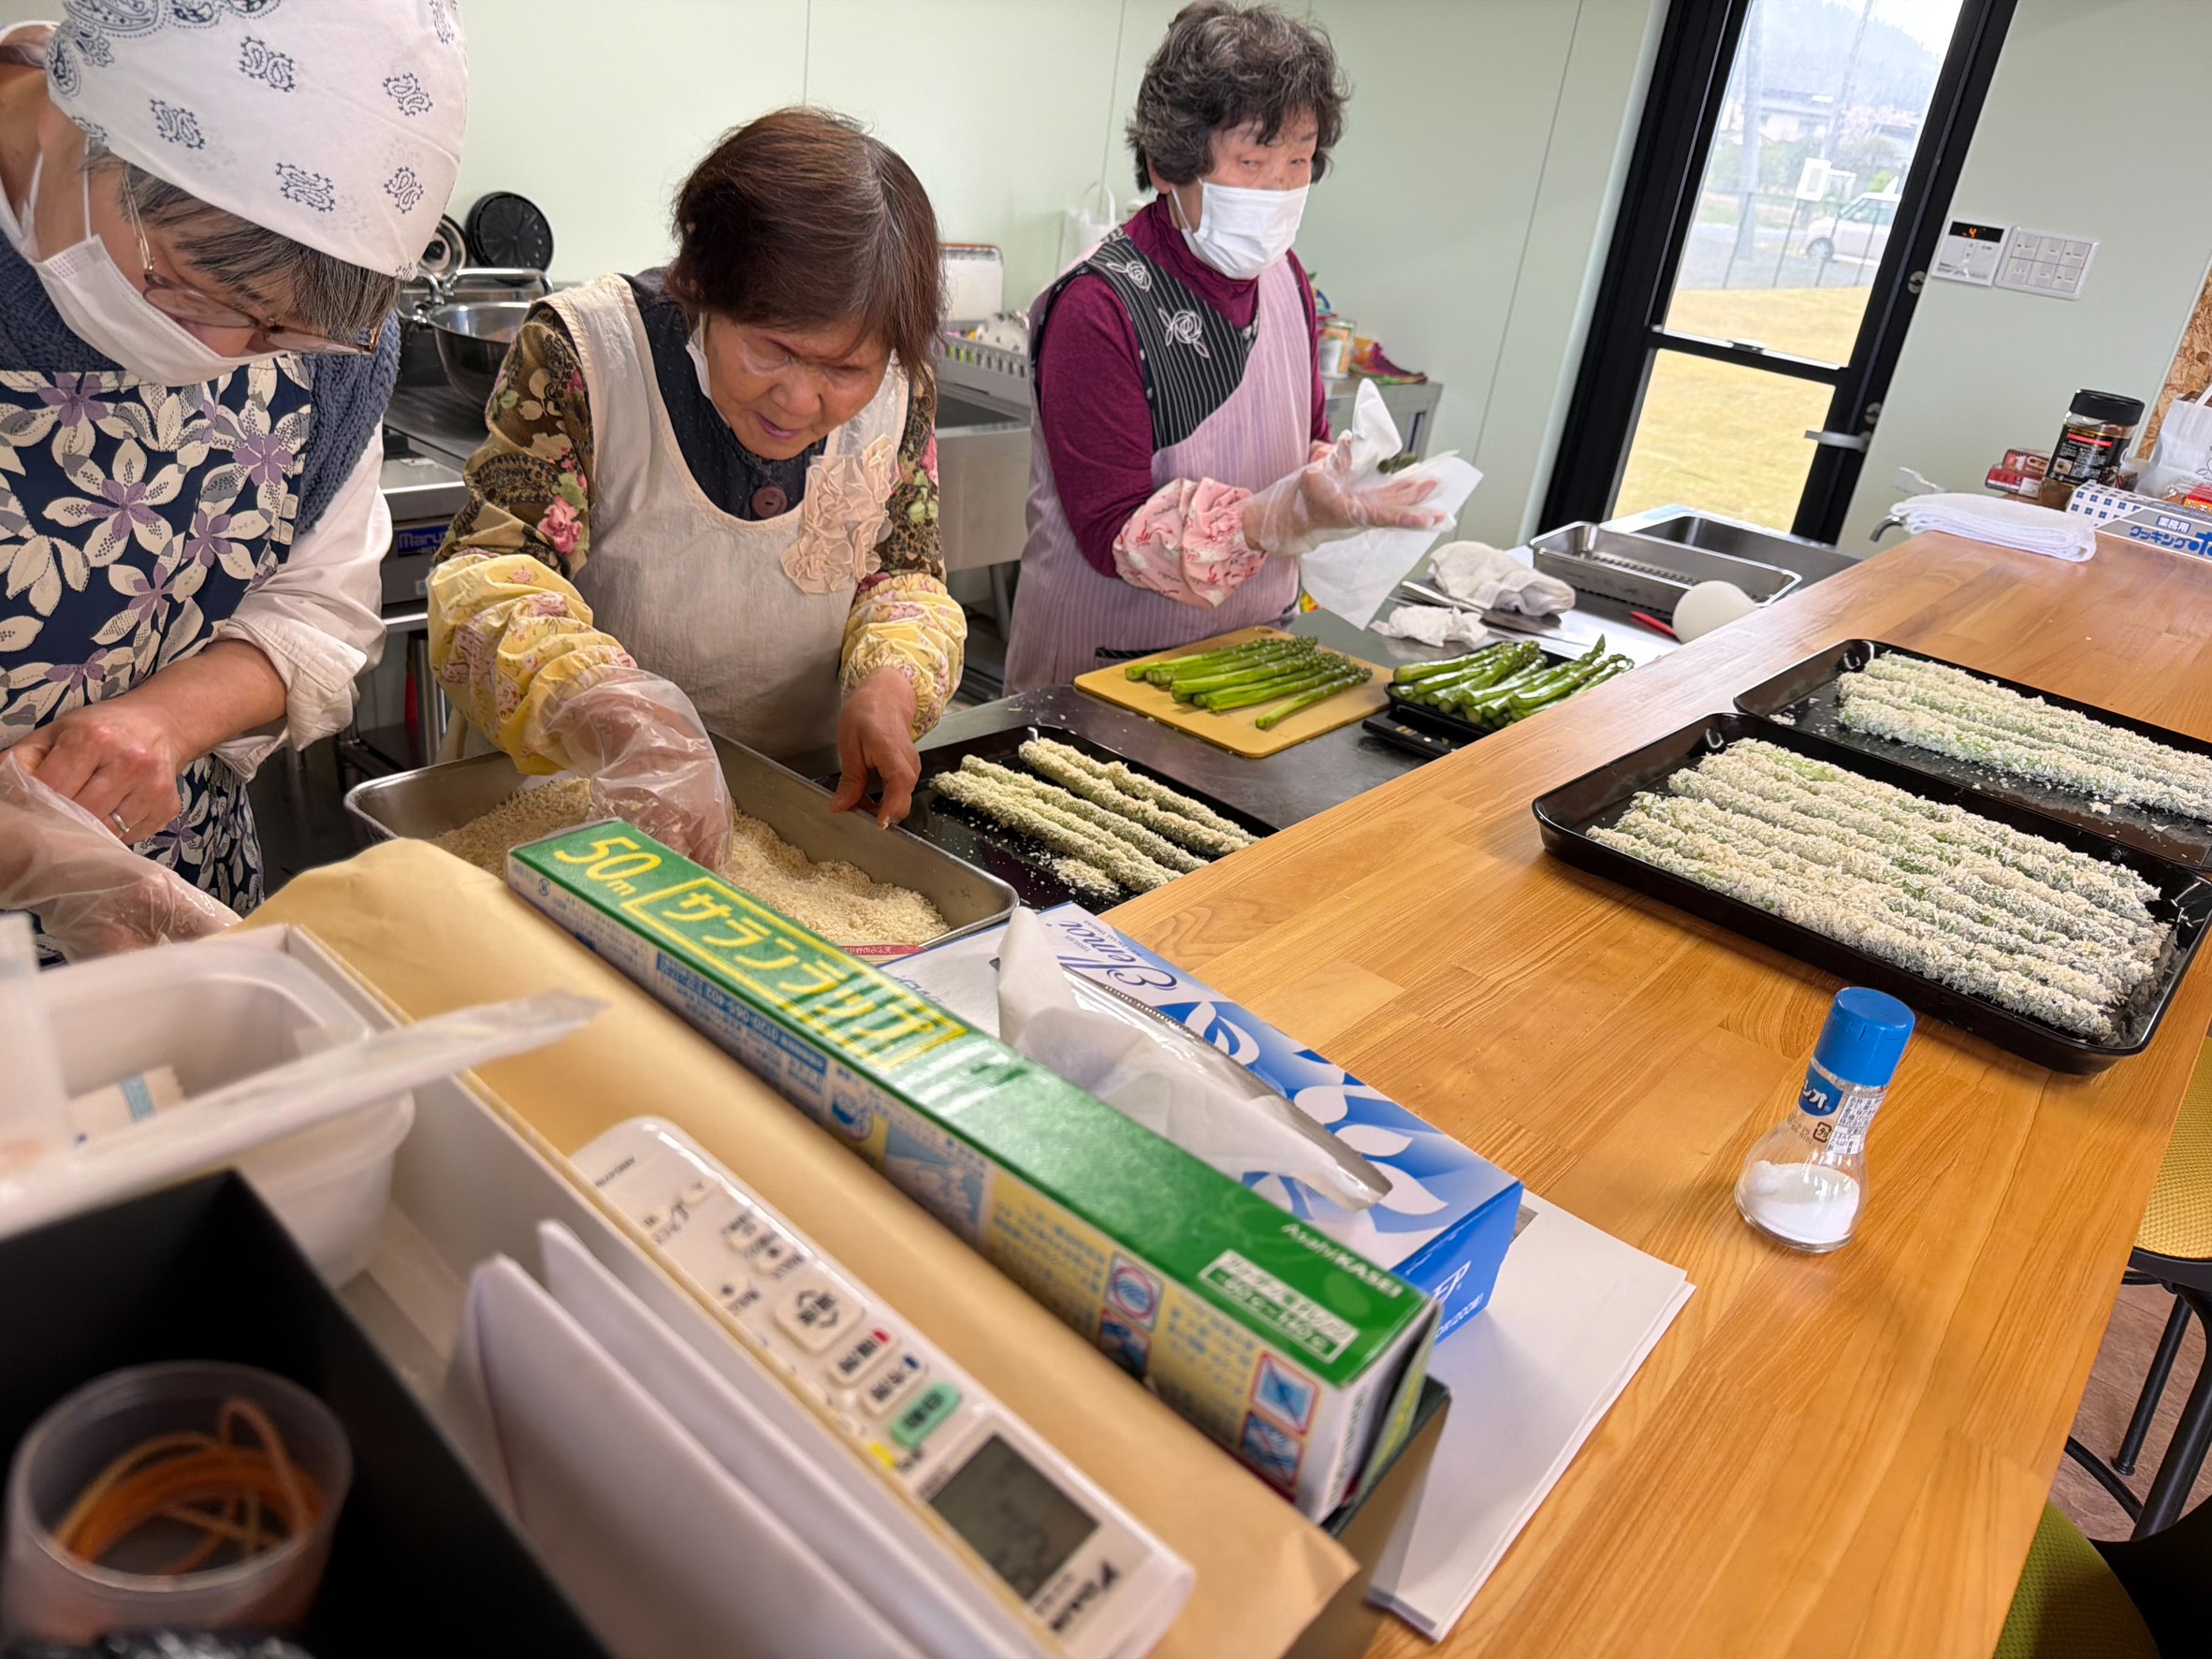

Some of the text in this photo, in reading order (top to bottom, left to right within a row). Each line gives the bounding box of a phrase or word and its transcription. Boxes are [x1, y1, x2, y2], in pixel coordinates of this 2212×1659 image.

[2157, 517, 2190, 533] 業務用
[662, 892, 935, 1040] サランラップ
